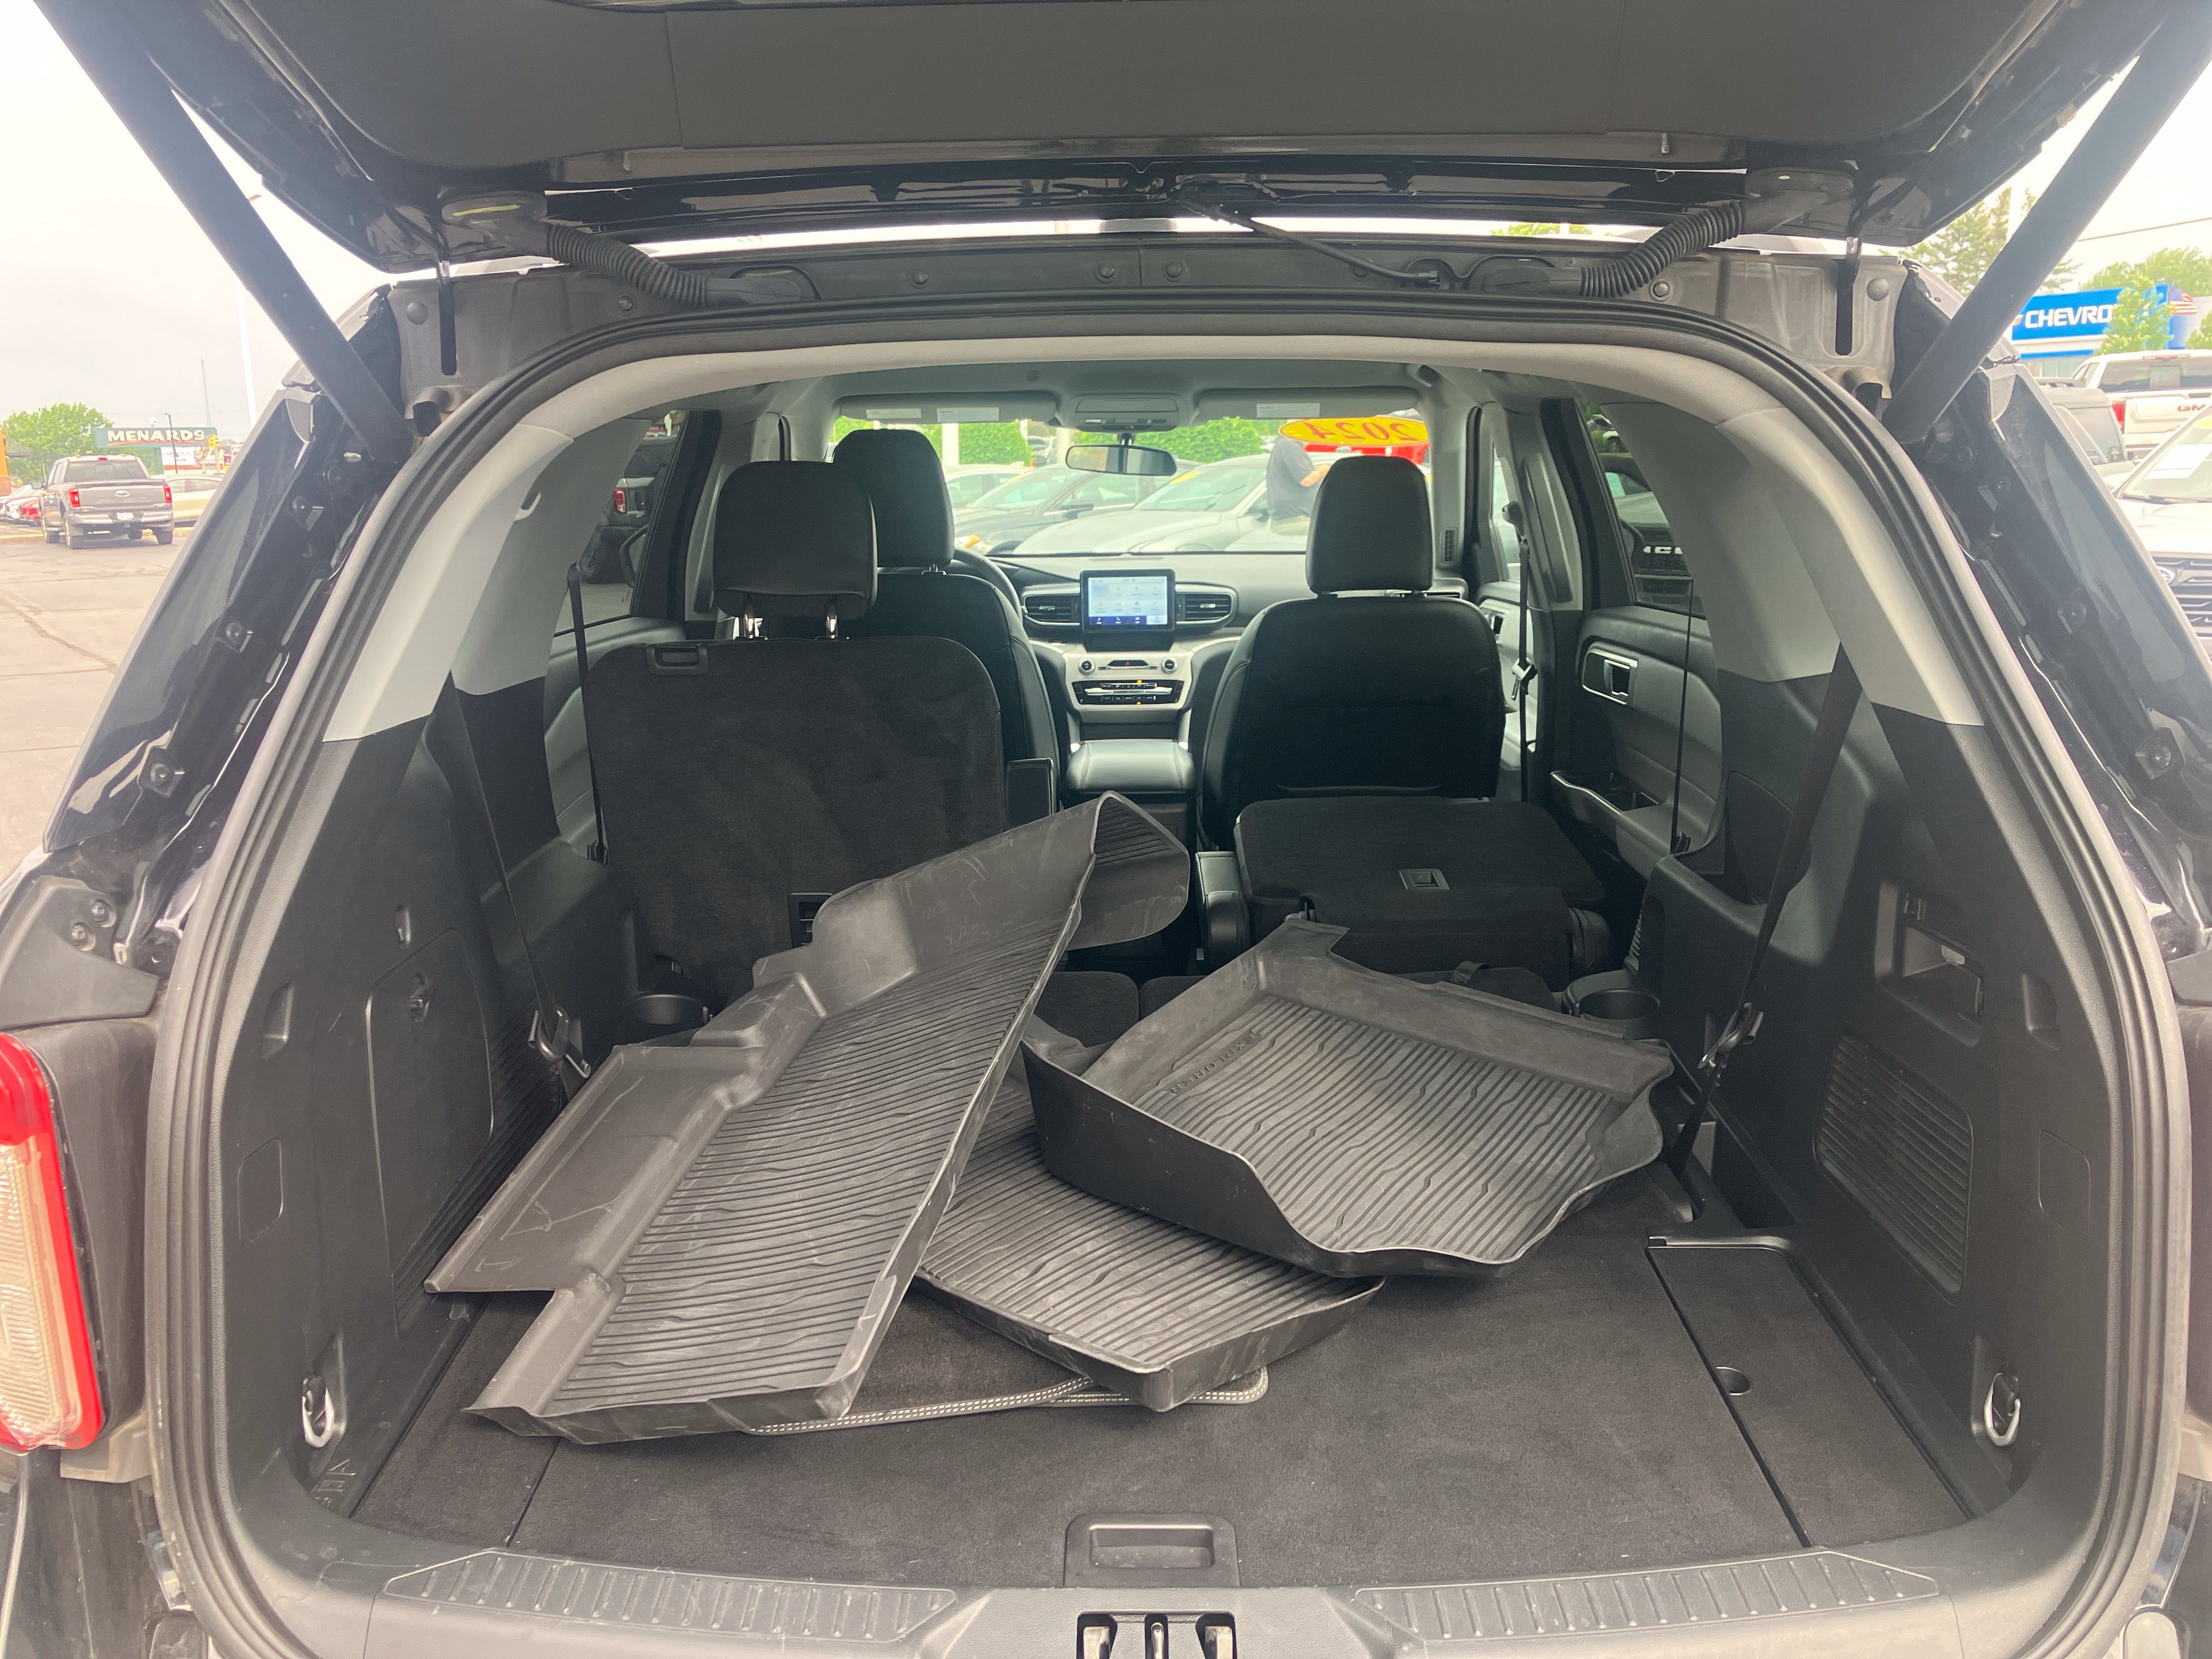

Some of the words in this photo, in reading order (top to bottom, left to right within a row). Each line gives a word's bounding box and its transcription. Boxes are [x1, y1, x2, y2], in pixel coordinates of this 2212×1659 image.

[2025, 304, 2119, 328] CHEVRO
[2177, 404, 2207, 412] GM
[107, 430, 205, 442] MENARDS
[1171, 1035, 1255, 1093] EXPLORER
